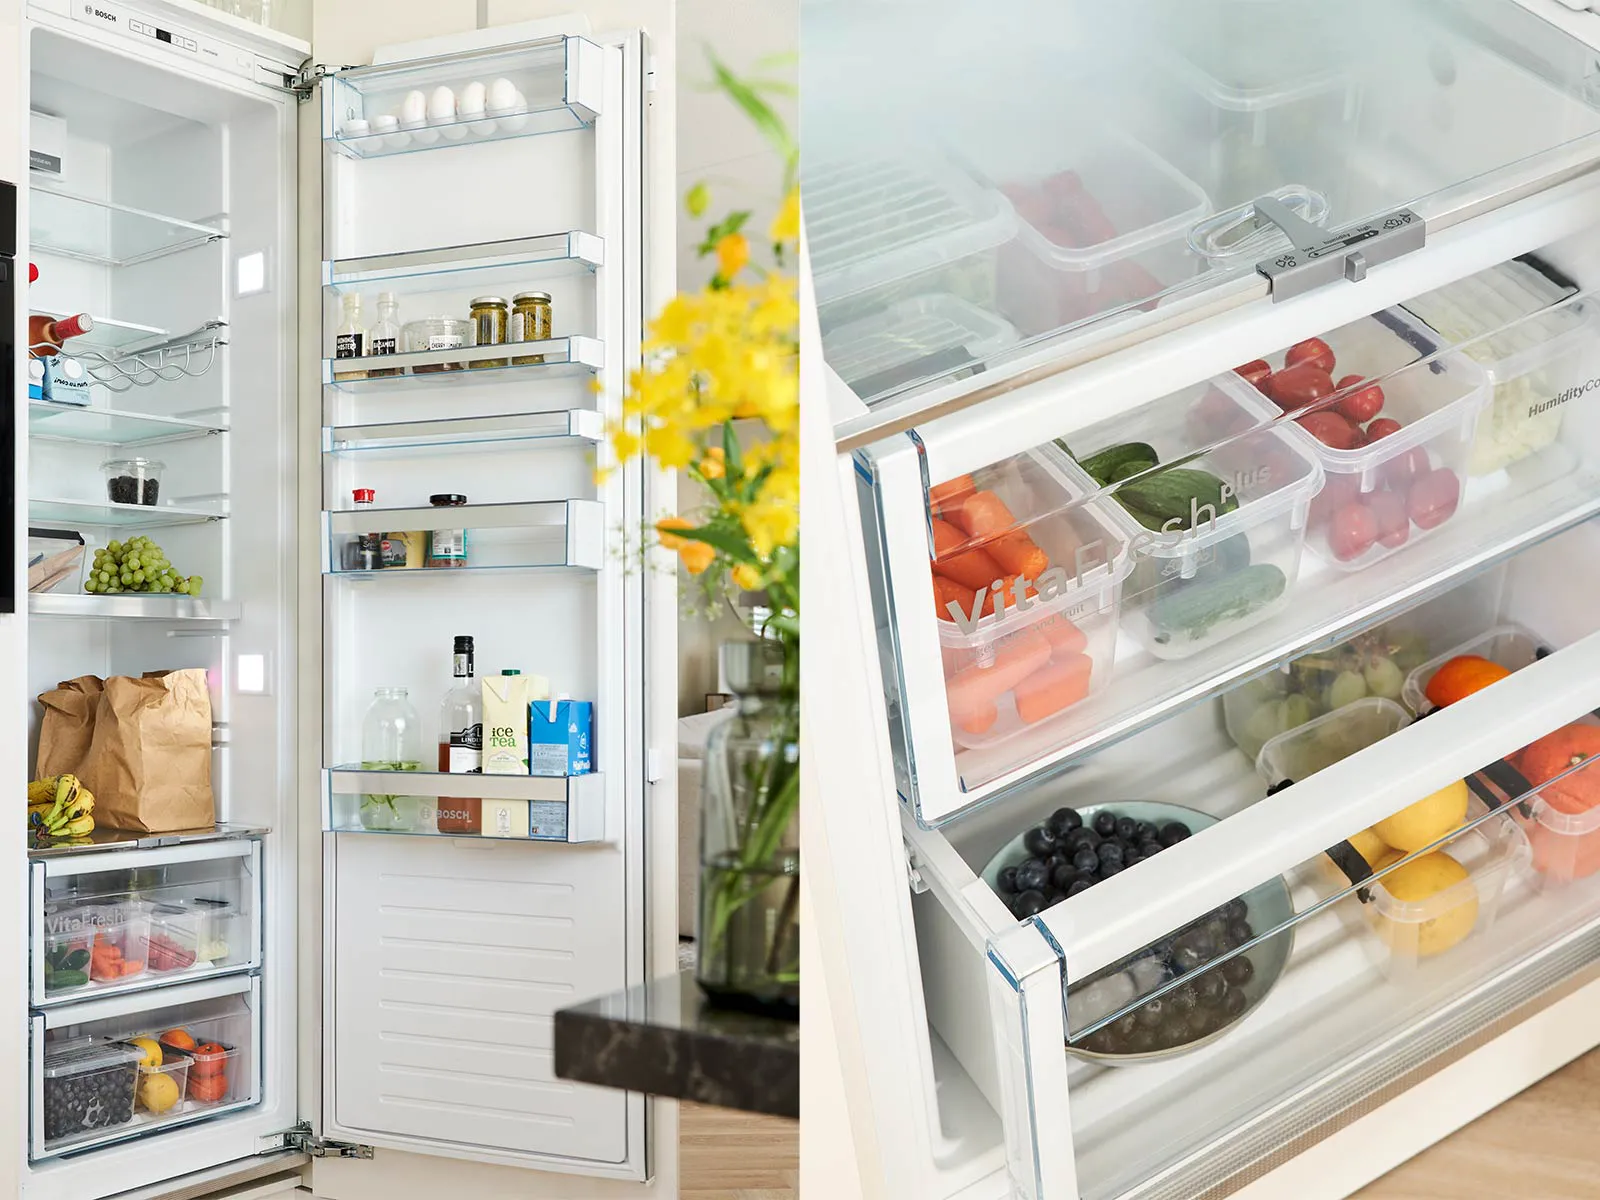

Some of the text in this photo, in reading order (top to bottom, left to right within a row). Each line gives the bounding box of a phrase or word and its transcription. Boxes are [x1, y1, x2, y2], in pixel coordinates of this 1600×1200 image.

[94, 9, 117, 22] BOSCH
[1323, 233, 1351, 244] humidity
[946, 464, 1273, 635] VitaFresh plus
[492, 727, 514, 738] ice
[436, 809, 470, 820] BOSCH
[46, 908, 124, 934] VitaFresh
